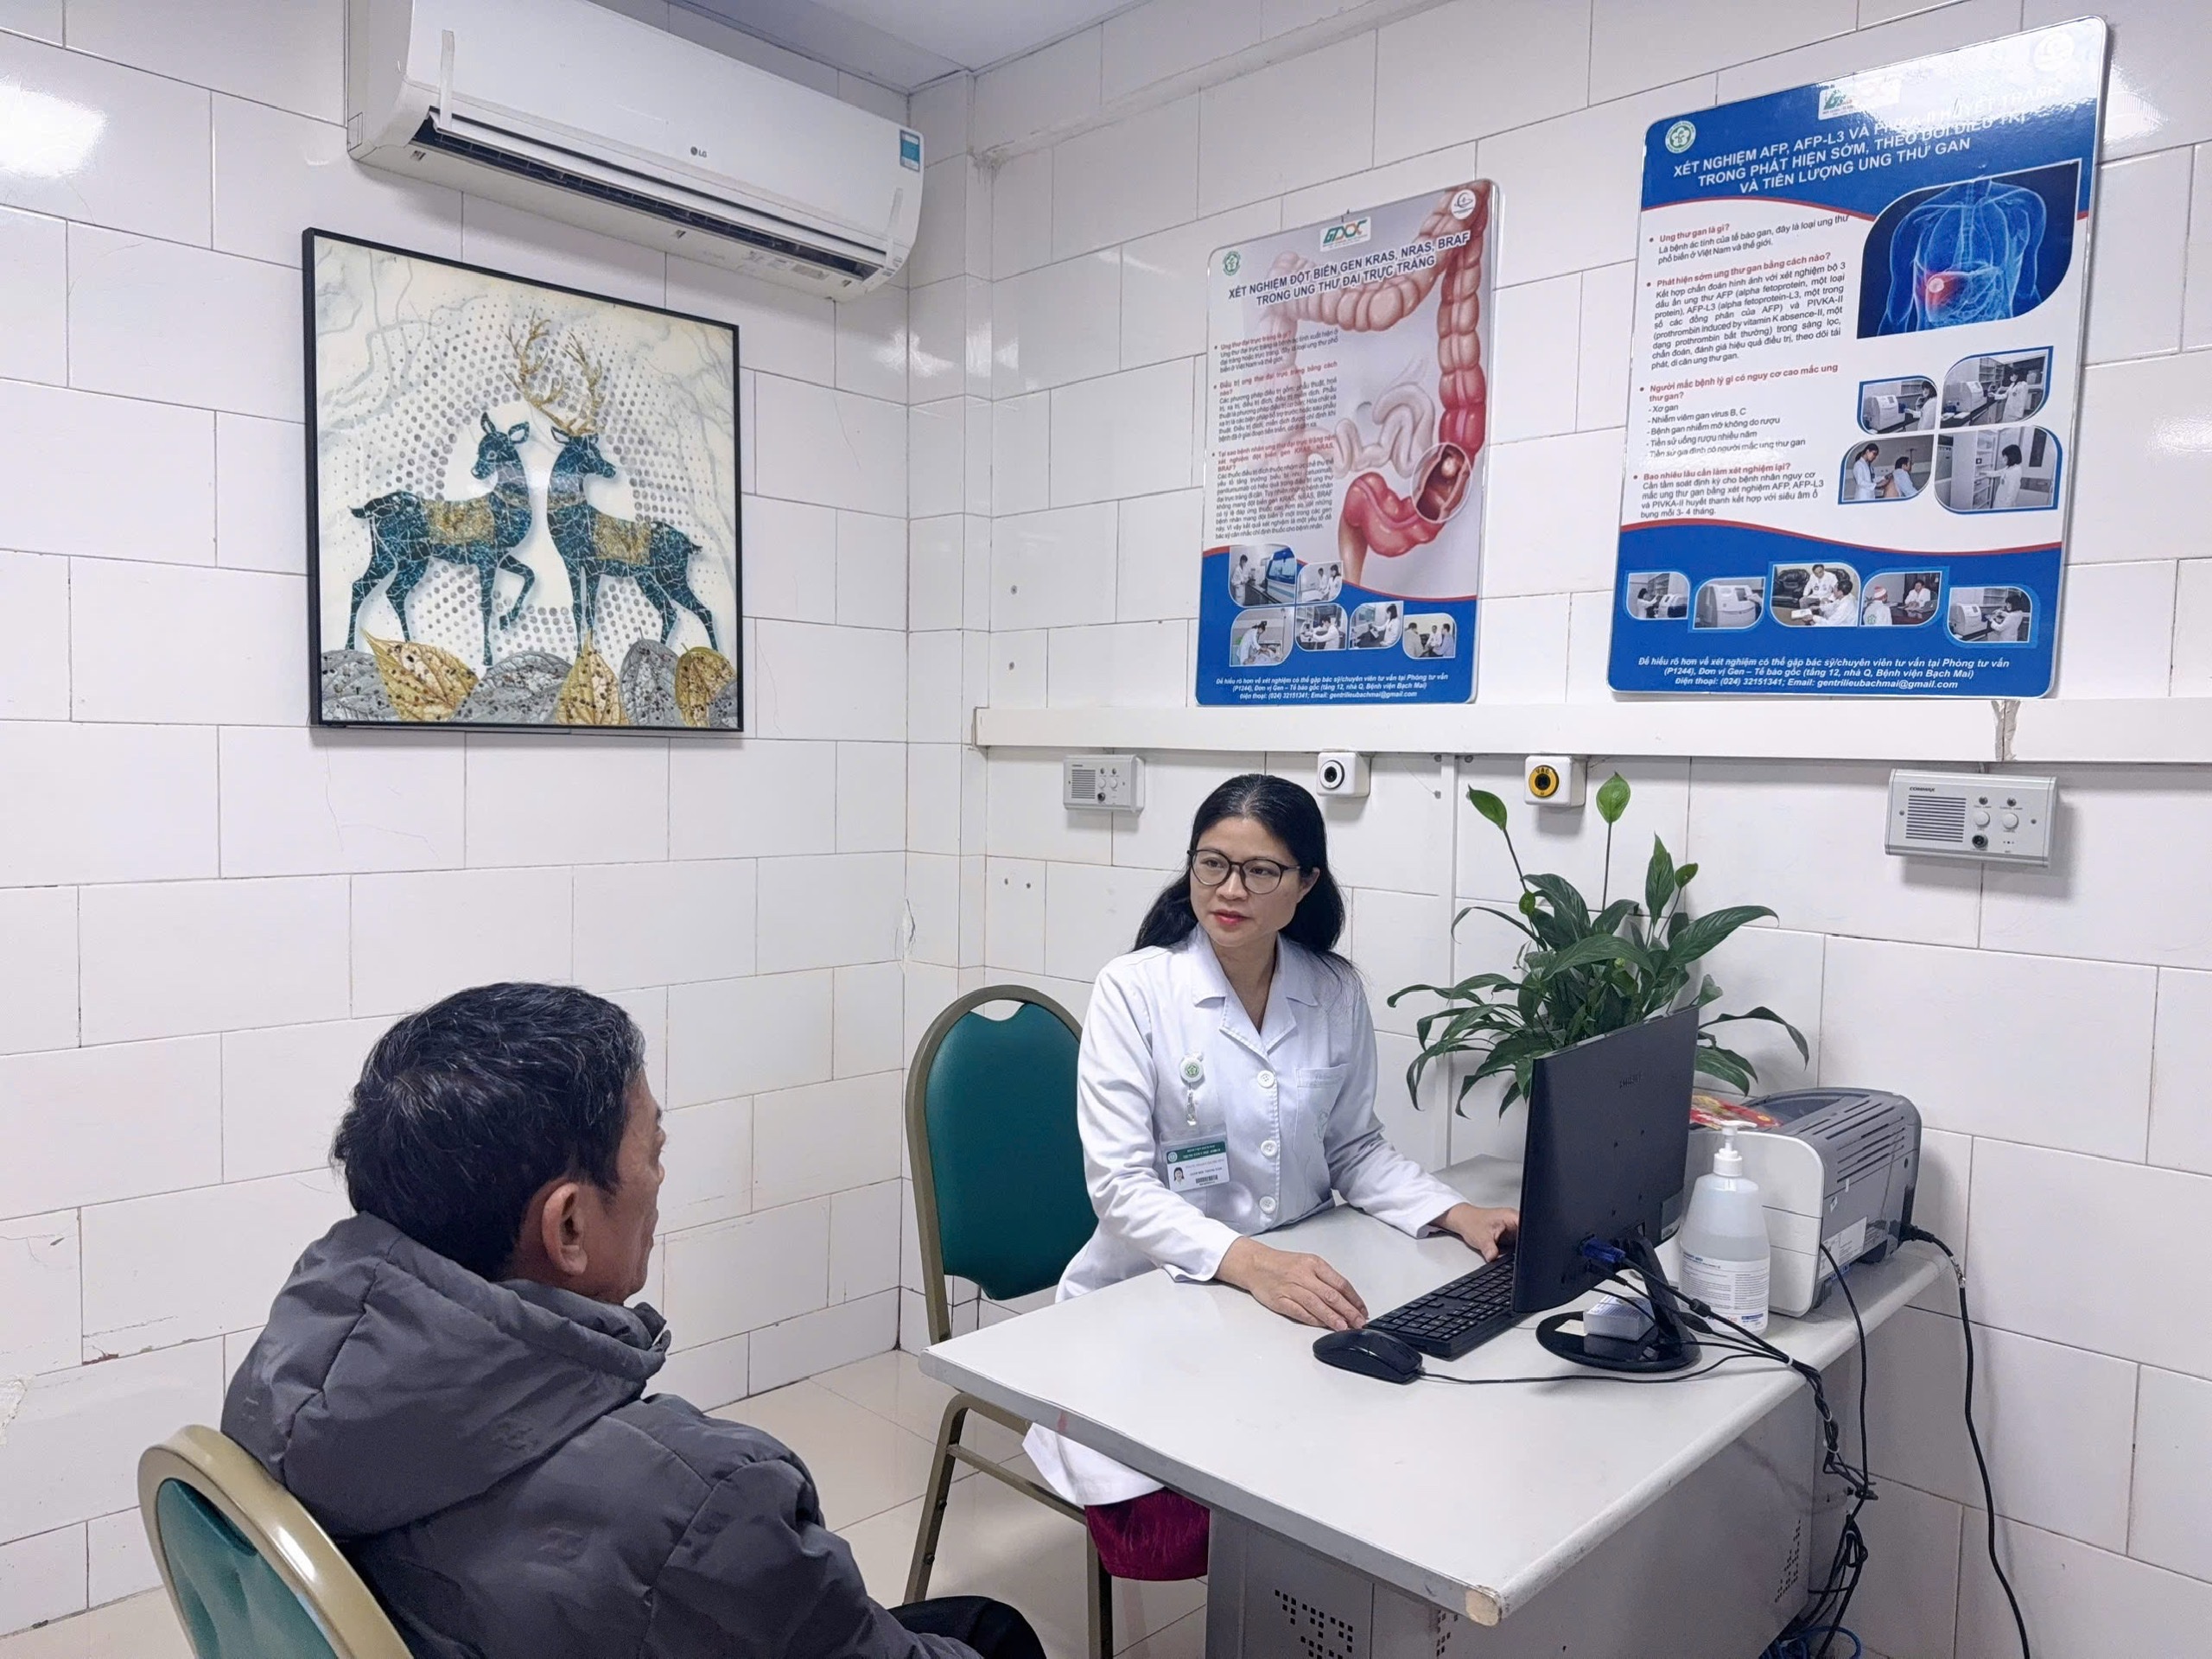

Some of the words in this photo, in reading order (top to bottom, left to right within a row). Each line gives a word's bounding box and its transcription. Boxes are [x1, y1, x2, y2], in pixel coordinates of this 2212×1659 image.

[699, 149, 707, 158] LG
[1674, 161, 1700, 175] XÉT
[1703, 149, 1756, 170] NGHIỆM
[1759, 143, 1789, 158] AFP,
[1793, 131, 1844, 151] AFP-L3
[1849, 124, 1869, 140] VÀ
[1698, 167, 1745, 186] TRONG
[1750, 158, 1788, 175] PHÁT
[1792, 150, 1825, 167] HIỆN
[1830, 143, 1869, 159] SỚM,
[1874, 133, 1916, 150] THEO
[1739, 177, 1758, 193] VÀ
[1762, 172, 1794, 188] TIÊN
[1798, 161, 1853, 181] LƯỢNG
[1858, 154, 1891, 169] UNG
[1936, 139, 1970, 155] GAN
[1692, 229, 1707, 238] gan
[1756, 229, 1773, 238] gan,
[1229, 285, 1246, 299] XÉT
[1249, 276, 1287, 294] NGHIỆM
[1290, 270, 1310, 285] ĐỘT
[1313, 262, 1337, 278] BIẾN
[1340, 258, 1362, 272] GEN
[1365, 251, 1397, 266] KRAS,
[1401, 242, 1433, 257] NRAS,
[1438, 232, 1469, 249] BRAF
[1256, 289, 1290, 305] TRONG
[1294, 283, 1314, 296] UNG
[1318, 277, 1340, 291] THƯ
[1343, 272, 1360, 286] ĐẠI
[1363, 265, 1392, 281] TRỰC
[1396, 255, 1434, 272] TRÀNG
[1760, 303, 1783, 313] AFP)
[1806, 295, 1843, 307] PIVKA-II
[1653, 326, 1700, 340] (prothrombin
[1700, 321, 1732, 332] induced
[1732, 320, 1742, 328] by
[1743, 316, 1771, 326] vitamin
[1779, 308, 1825, 321] absence-II,
[1716, 377, 1724, 385] lý
[1726, 375, 1733, 385] gì
[1746, 373, 1768, 382] nguy
[1663, 391, 1684, 401] gan?
[1792, 480, 1823, 488] AFP-L3
[1663, 667, 1695, 676] (P1244),
[1743, 677, 1785, 686] 32151341;
[1817, 679, 1958, 689] gentrilieubachmai@gmail.com
